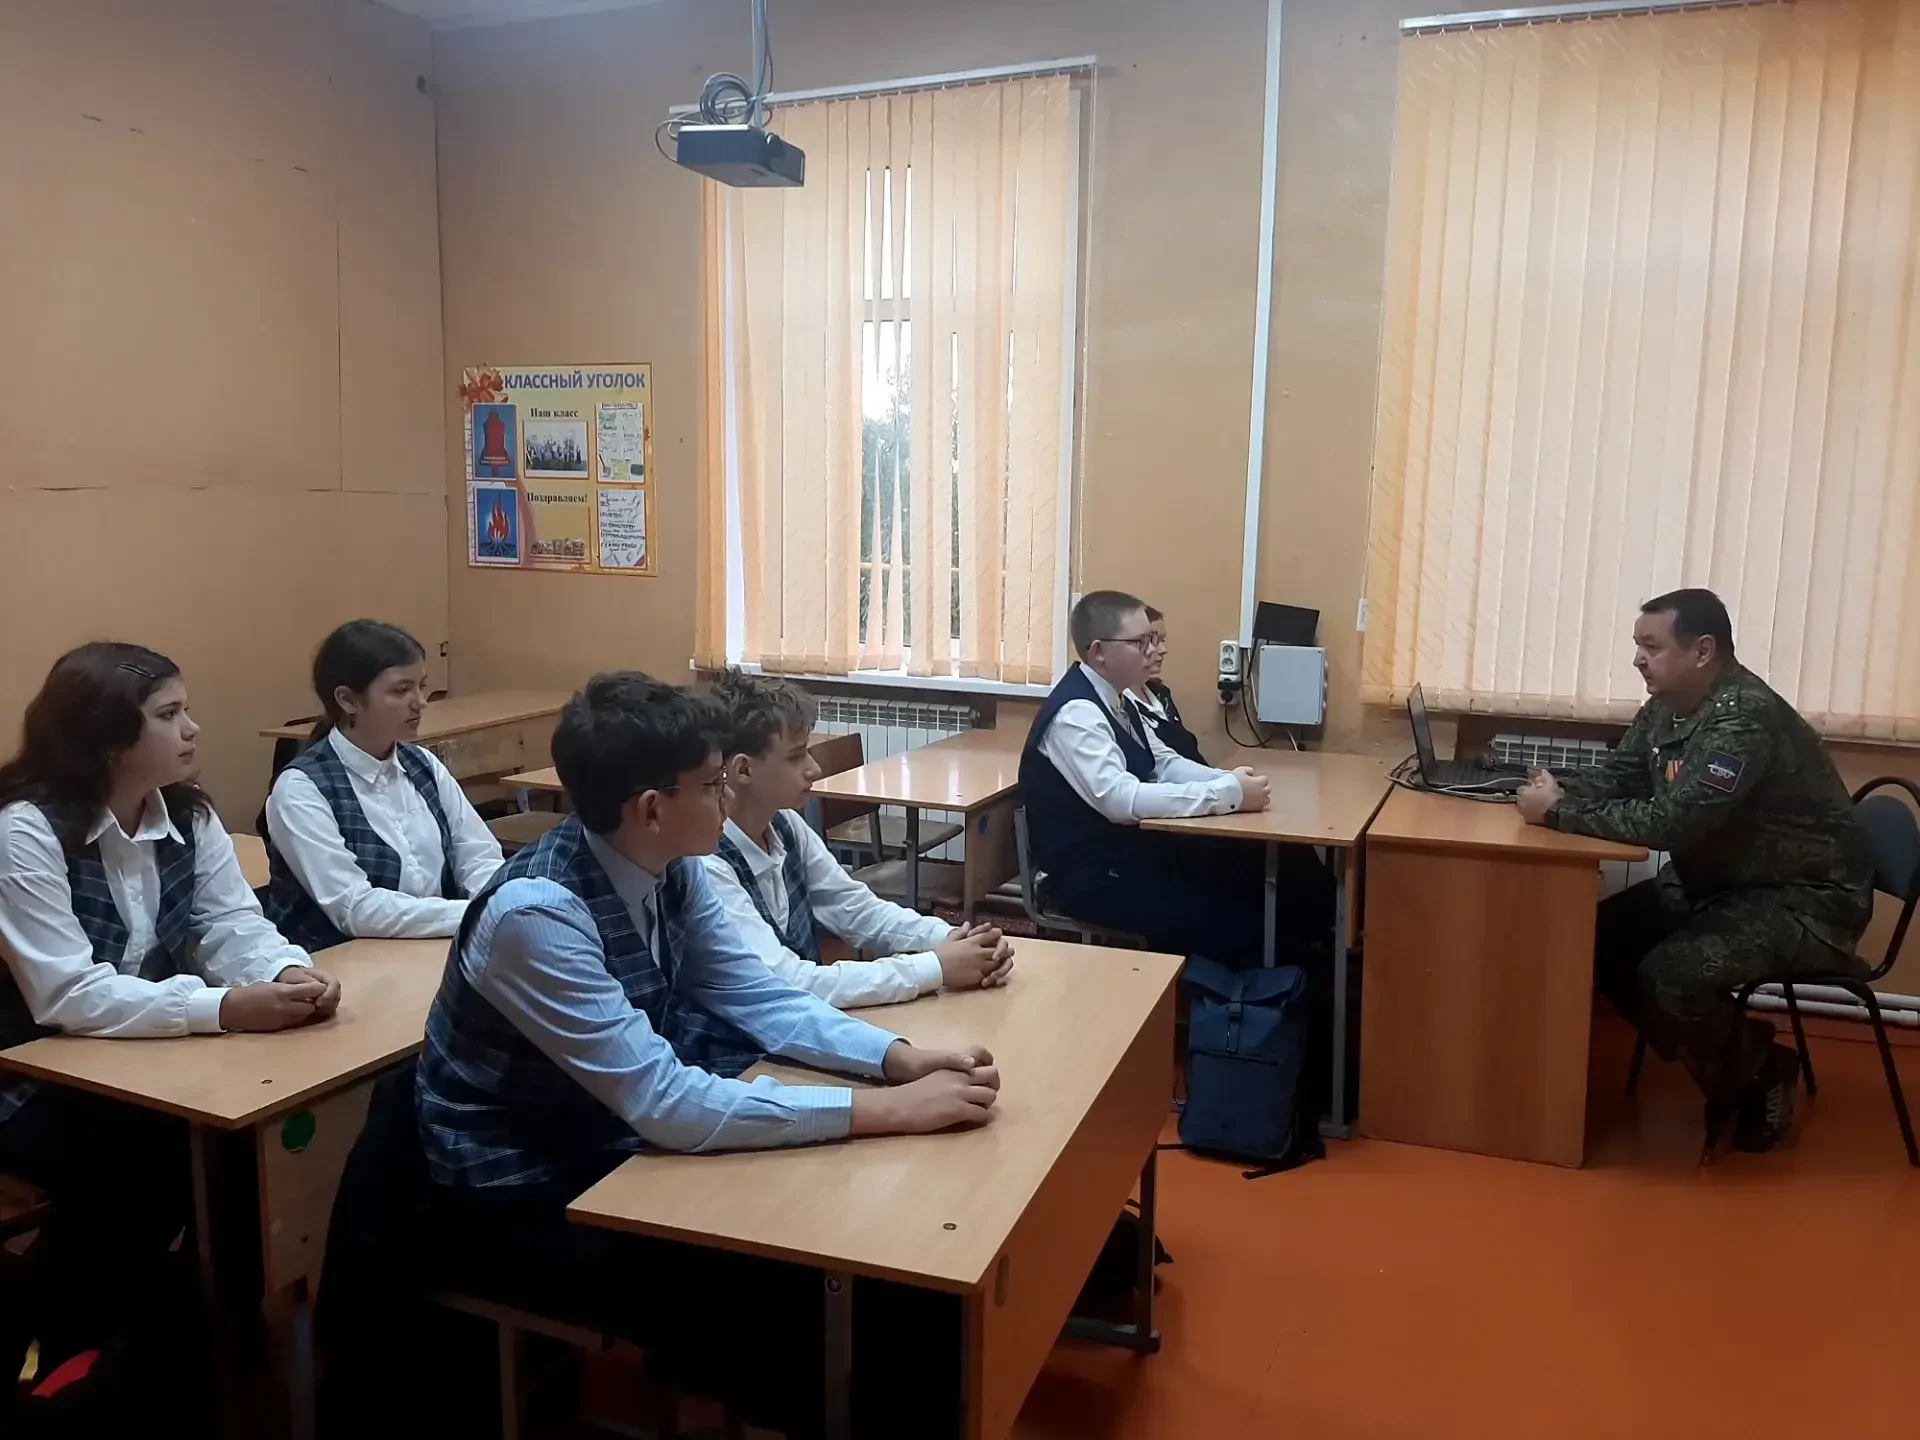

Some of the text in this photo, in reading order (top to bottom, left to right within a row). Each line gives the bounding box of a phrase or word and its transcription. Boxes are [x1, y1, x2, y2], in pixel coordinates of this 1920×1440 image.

[504, 370, 645, 389] КЛАССНЫЙ УГОЛОК
[530, 408, 579, 418] Наш класс
[527, 492, 588, 505] Поздравляем!
